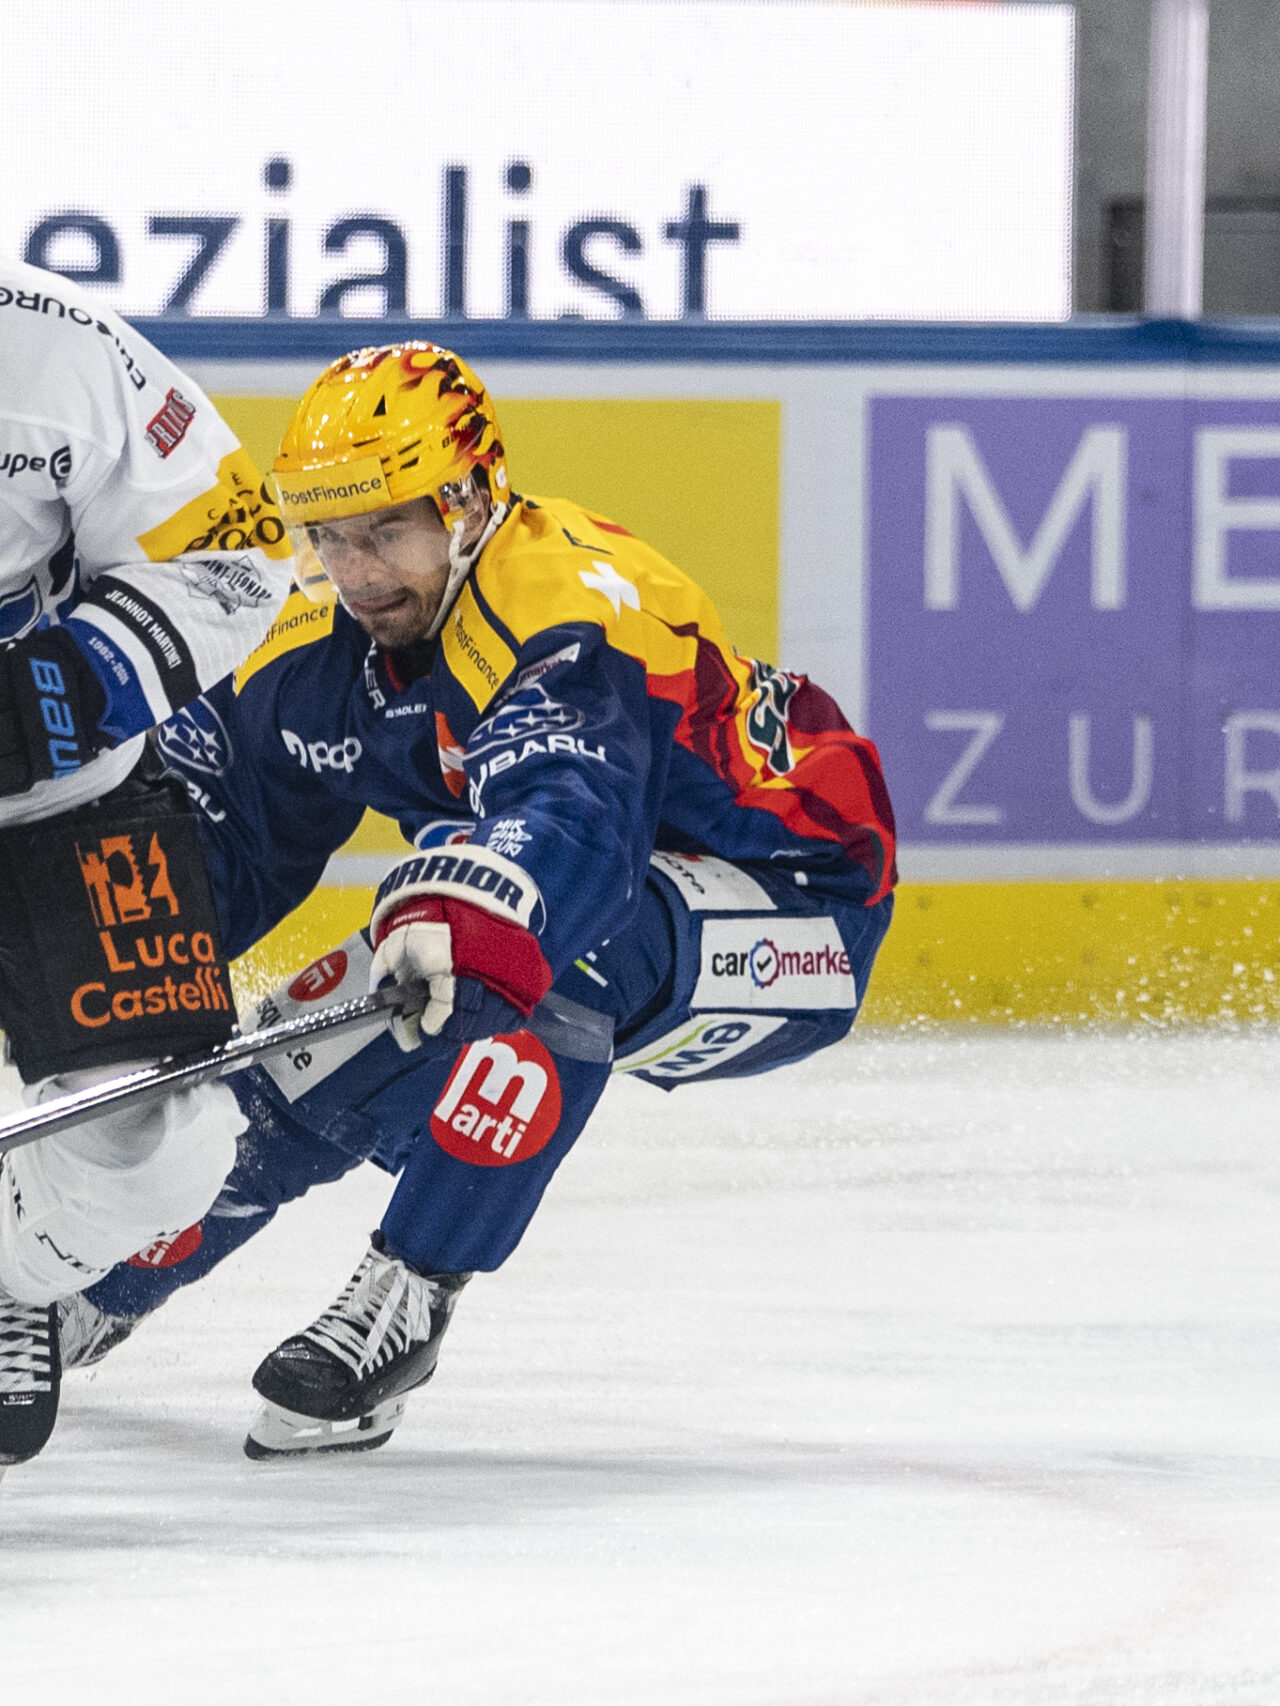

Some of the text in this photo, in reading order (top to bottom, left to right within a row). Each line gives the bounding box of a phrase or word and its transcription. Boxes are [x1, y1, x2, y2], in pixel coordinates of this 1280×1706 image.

[281, 474, 382, 507] PostFinance
[104, 589, 154, 627] JEANNOT
[468, 734, 607, 820] SUBARU
[99, 931, 217, 973] Luca
[71, 966, 230, 1029] Castelli
